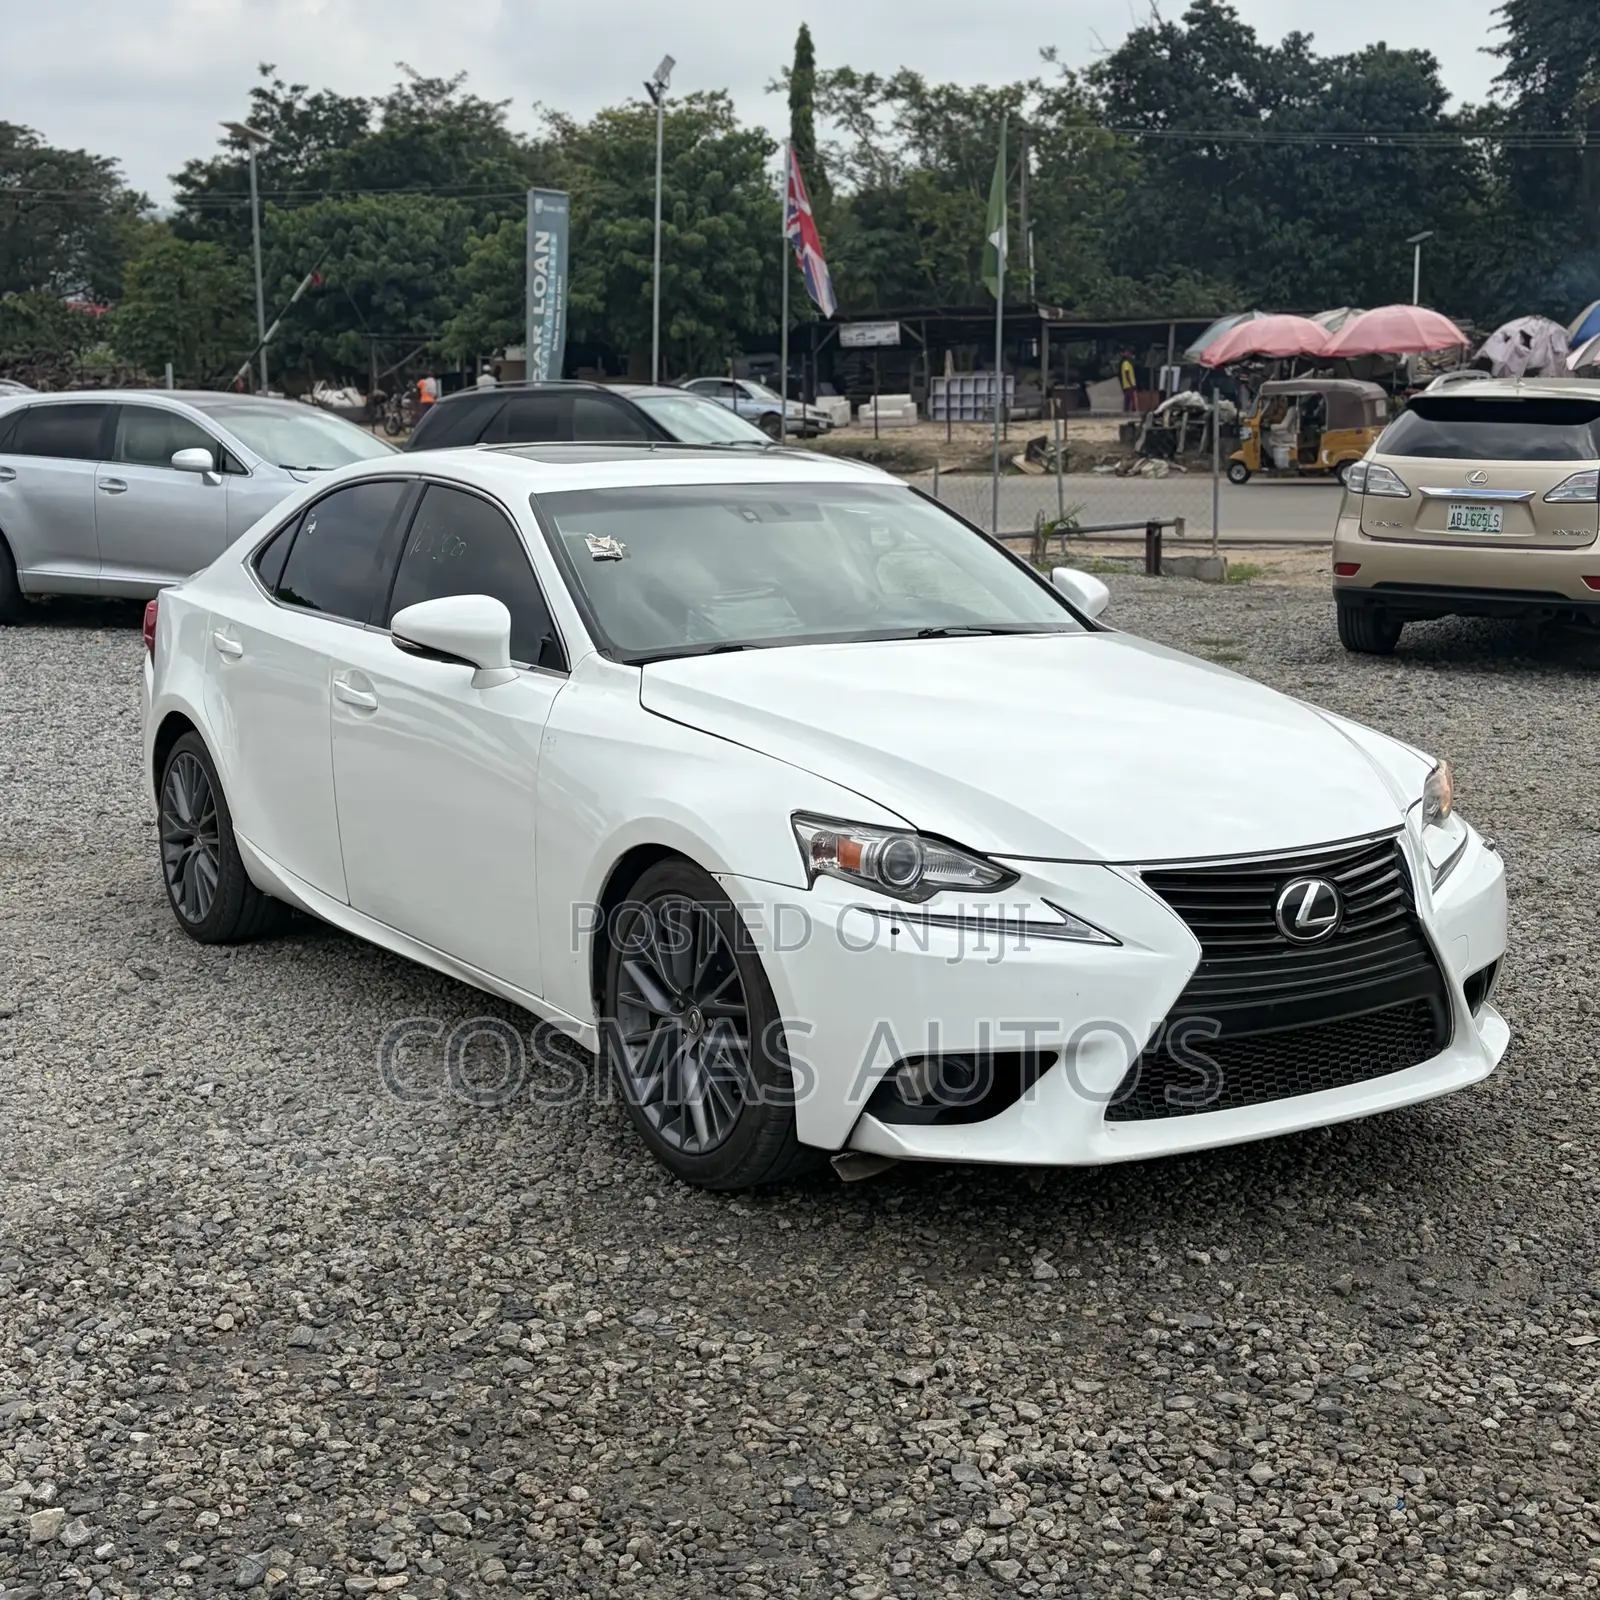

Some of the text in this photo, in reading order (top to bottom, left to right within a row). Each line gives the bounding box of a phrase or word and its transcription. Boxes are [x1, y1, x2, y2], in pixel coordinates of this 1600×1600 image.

[532, 230, 550, 387] CAR LOAN
[1450, 512, 1500, 528] ABJ-625LS
